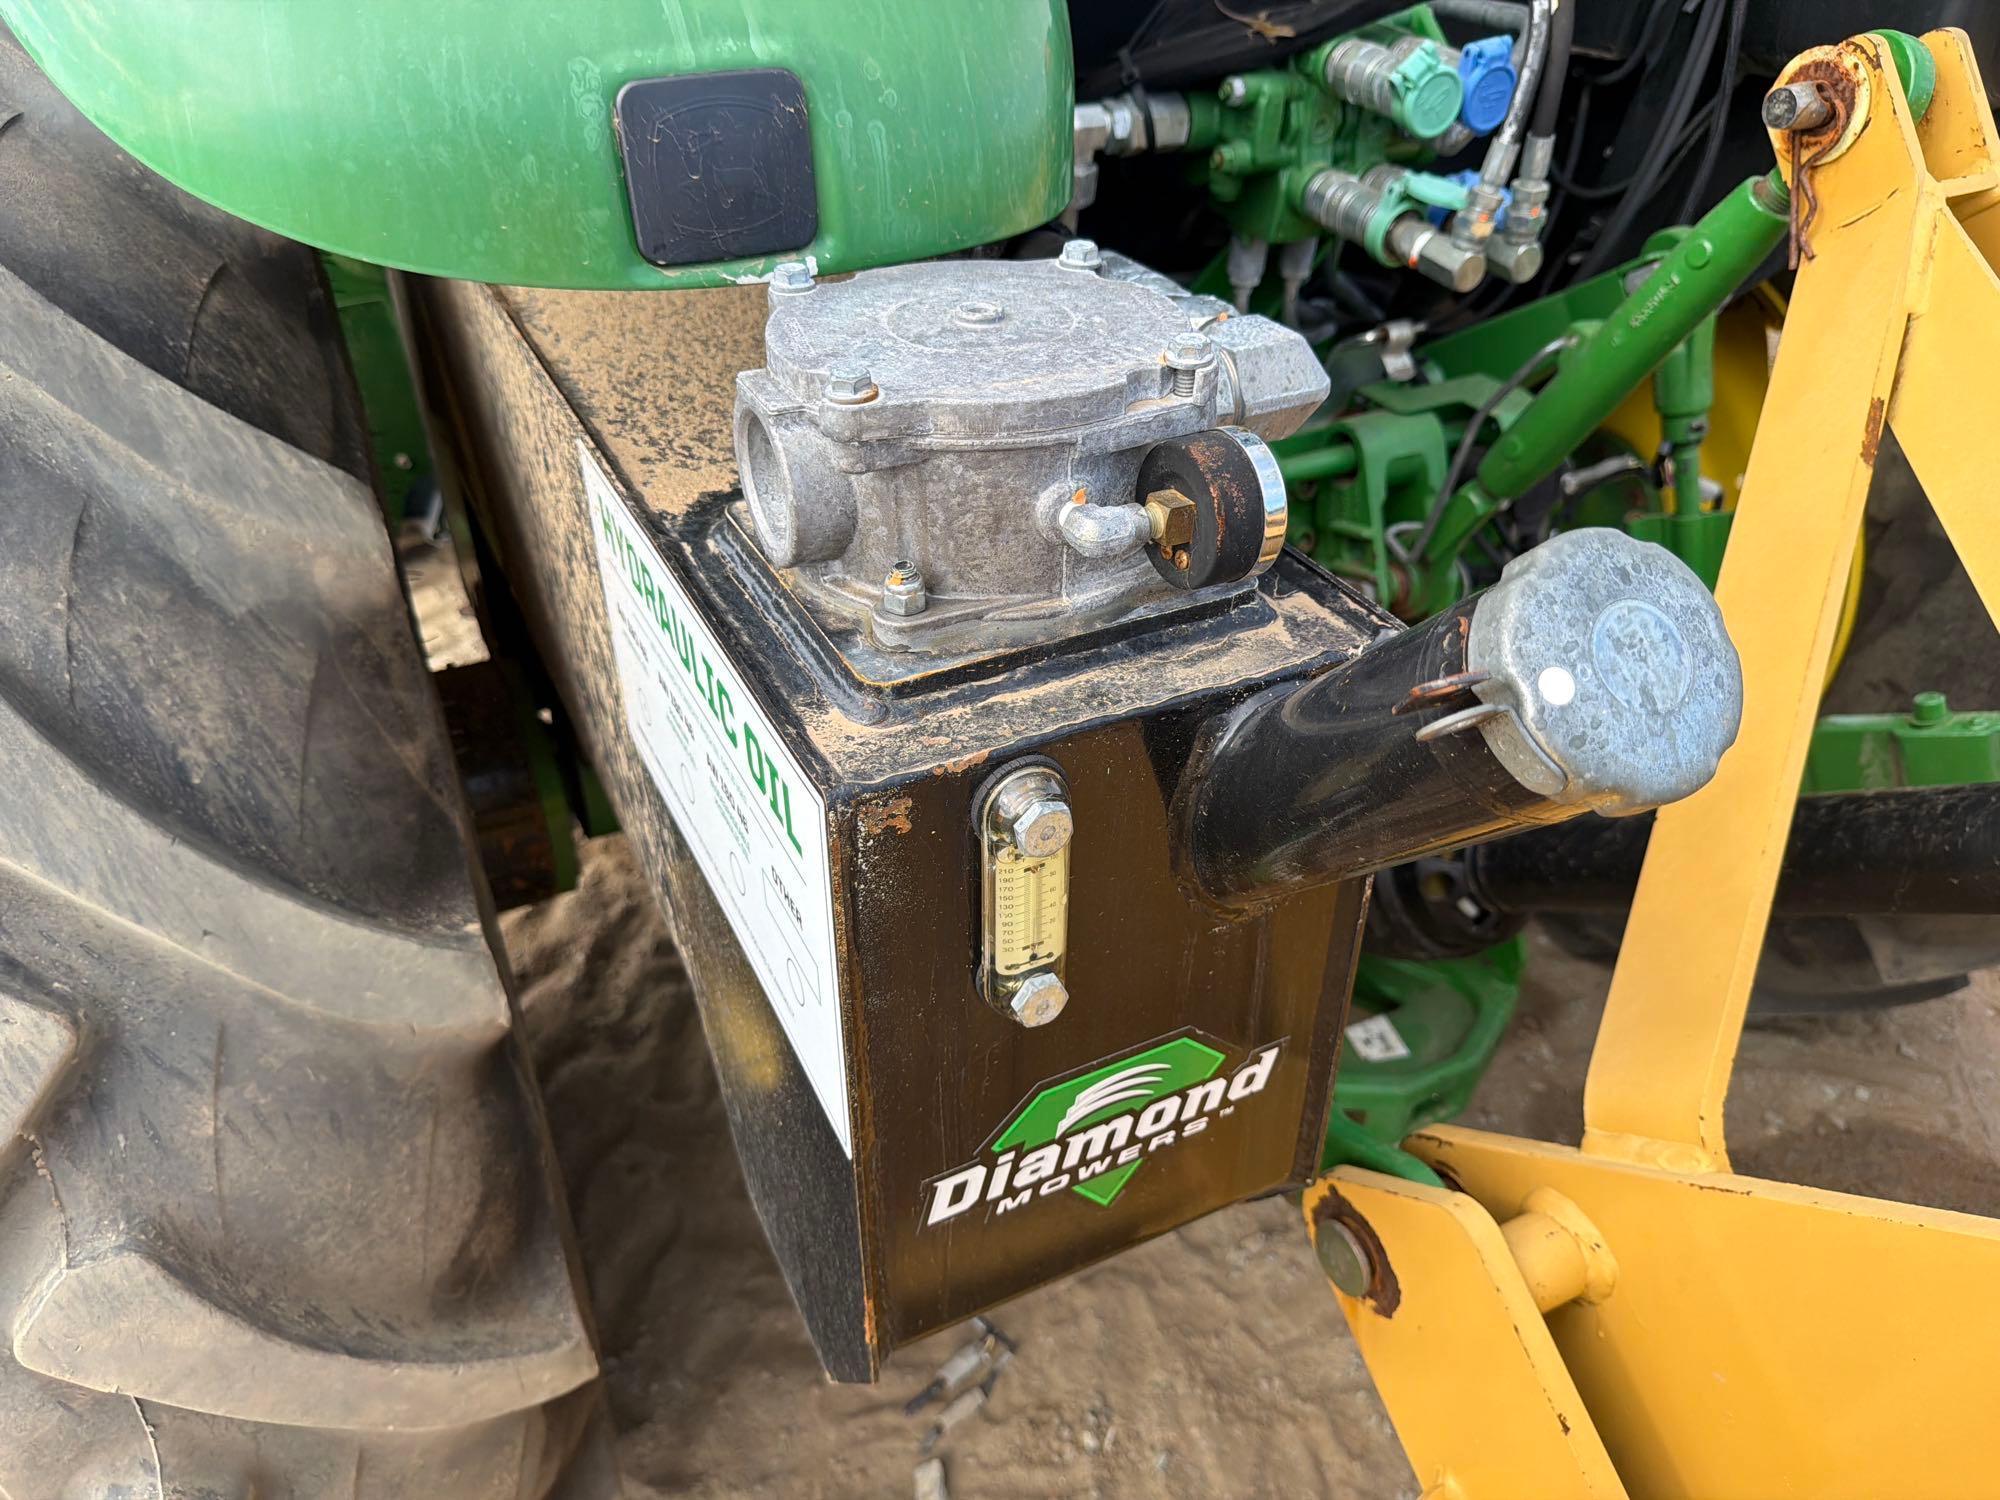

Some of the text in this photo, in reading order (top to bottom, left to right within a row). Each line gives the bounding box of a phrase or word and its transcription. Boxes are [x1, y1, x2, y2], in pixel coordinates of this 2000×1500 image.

[598, 494, 738, 749] HYDRAULIC
[743, 721, 803, 857] OIL
[771, 865, 804, 931] OTHER
[927, 1046, 1280, 1227] Diamond
[995, 1117, 1209, 1216] MOWERS
